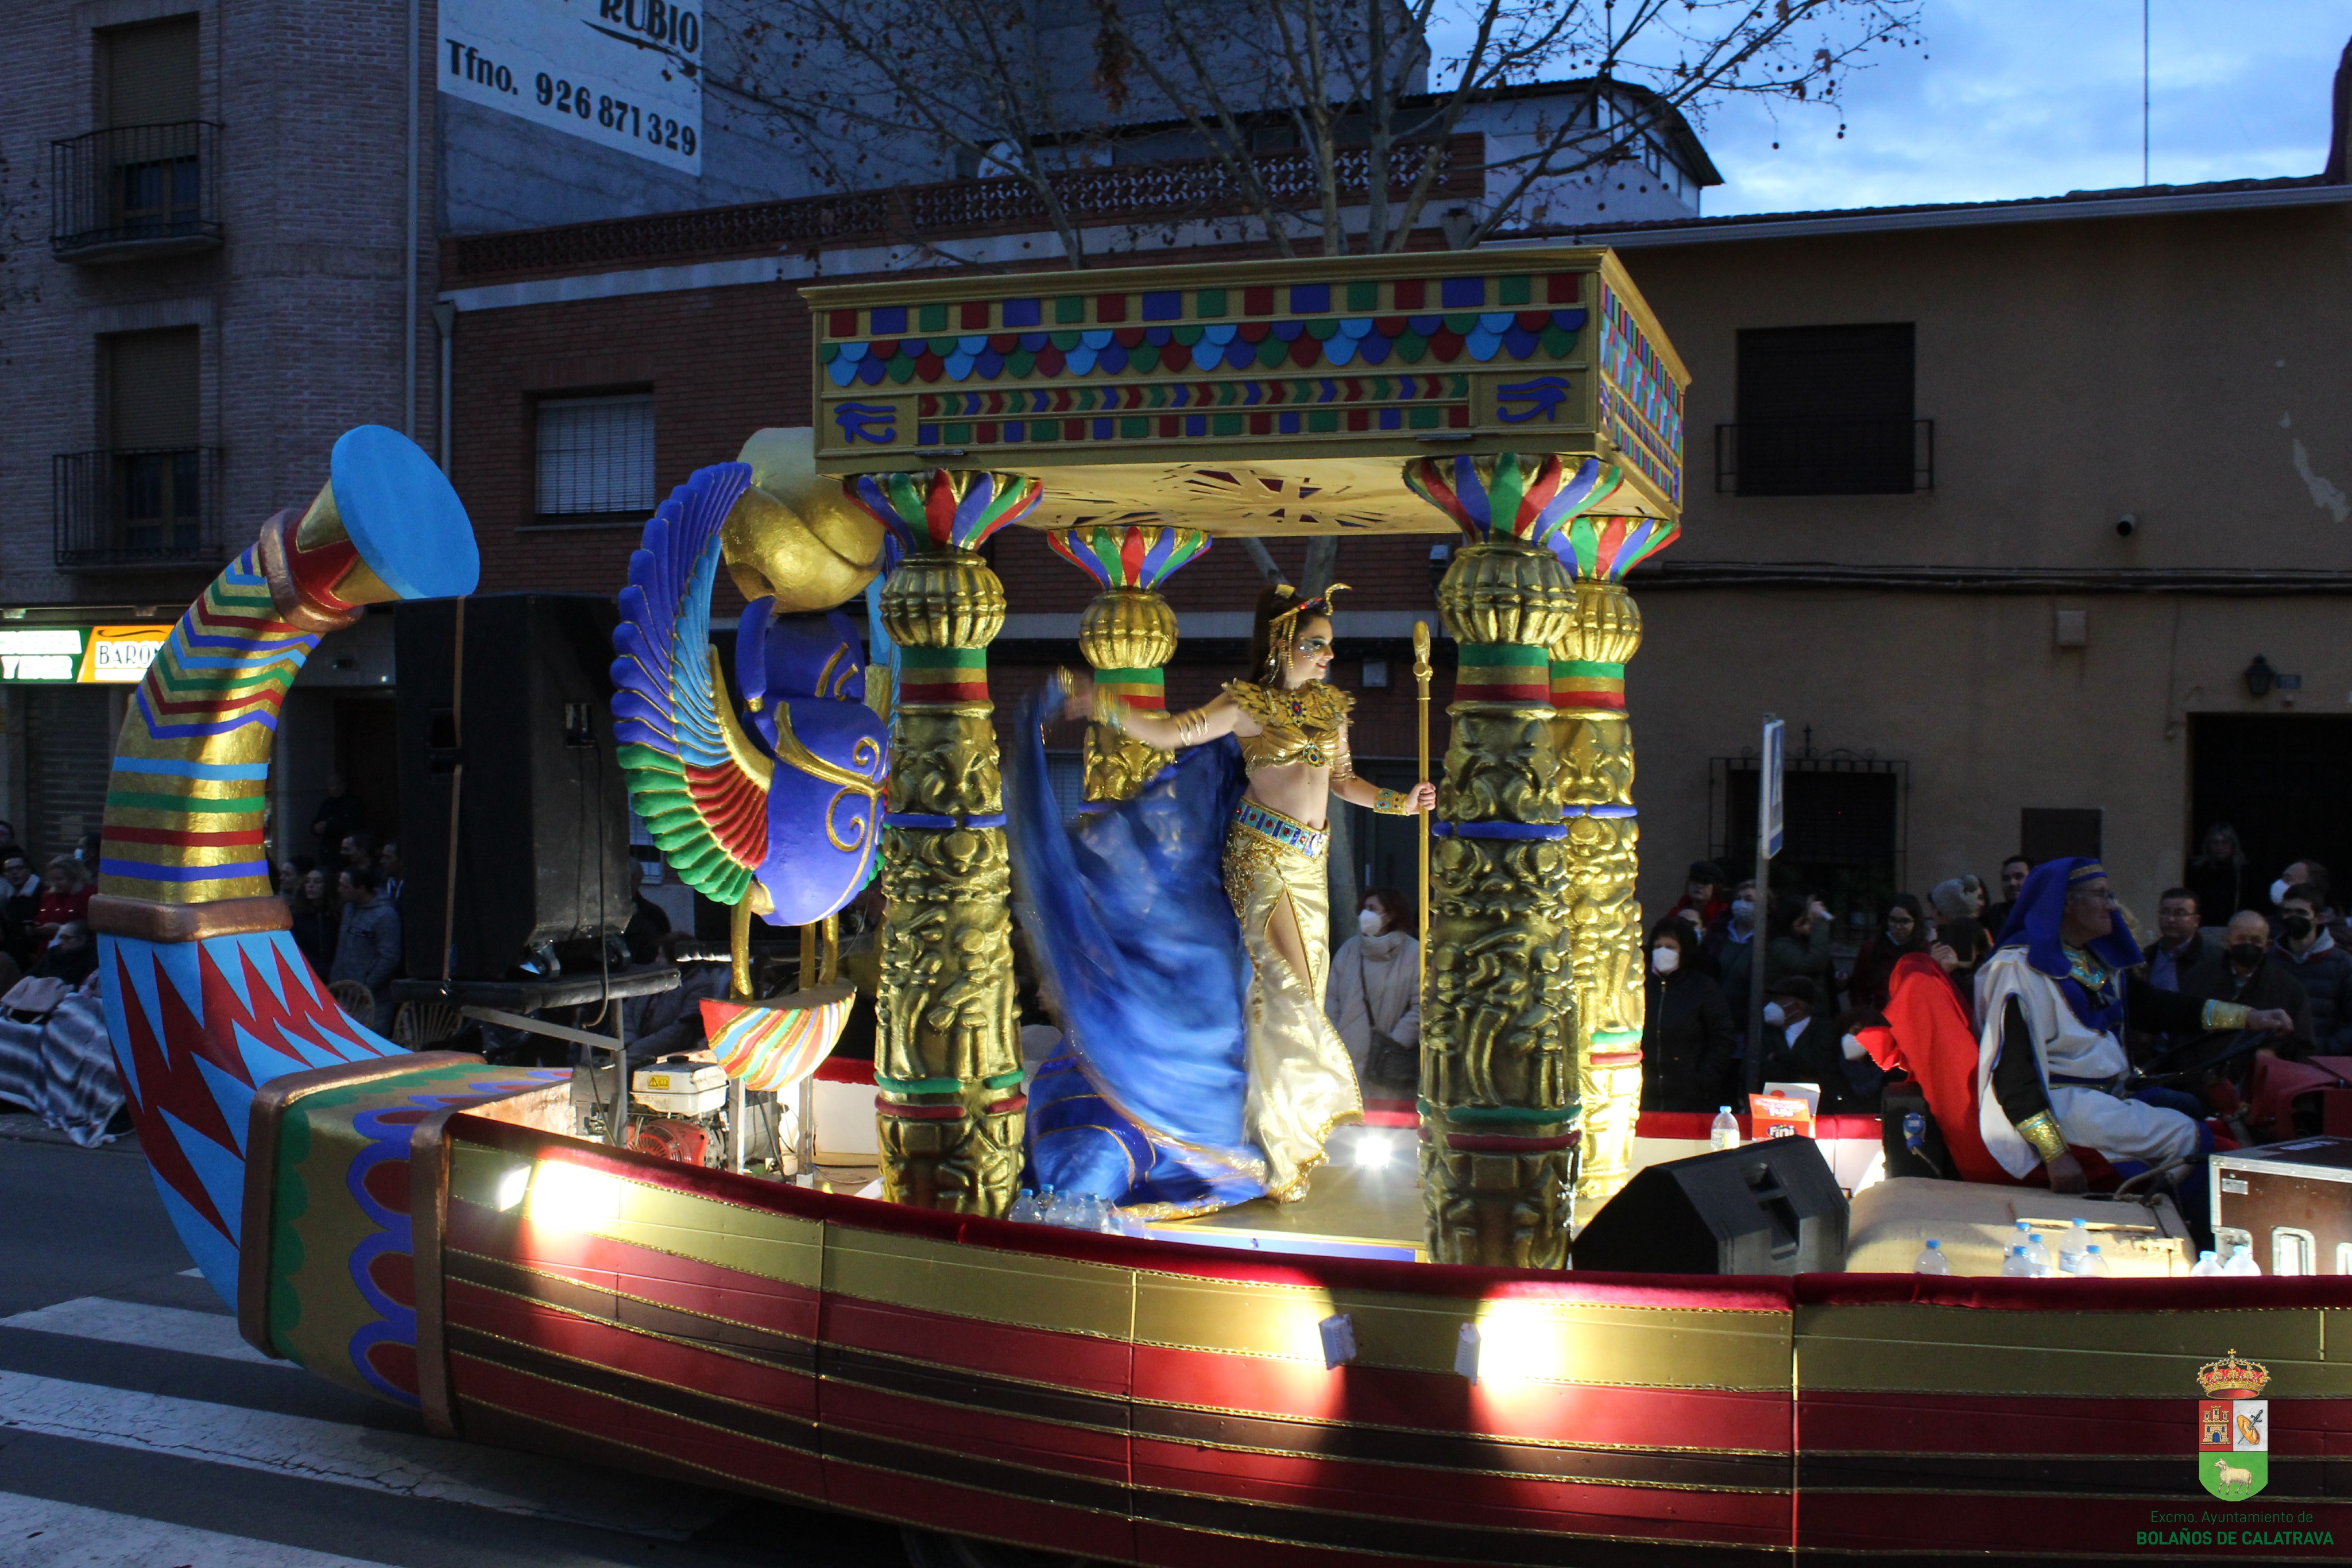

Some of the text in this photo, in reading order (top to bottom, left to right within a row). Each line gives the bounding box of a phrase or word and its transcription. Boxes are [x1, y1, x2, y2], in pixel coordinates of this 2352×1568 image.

[446, 38, 696, 156] Tfno. 926 871 329
[99, 645, 159, 664] BARO
